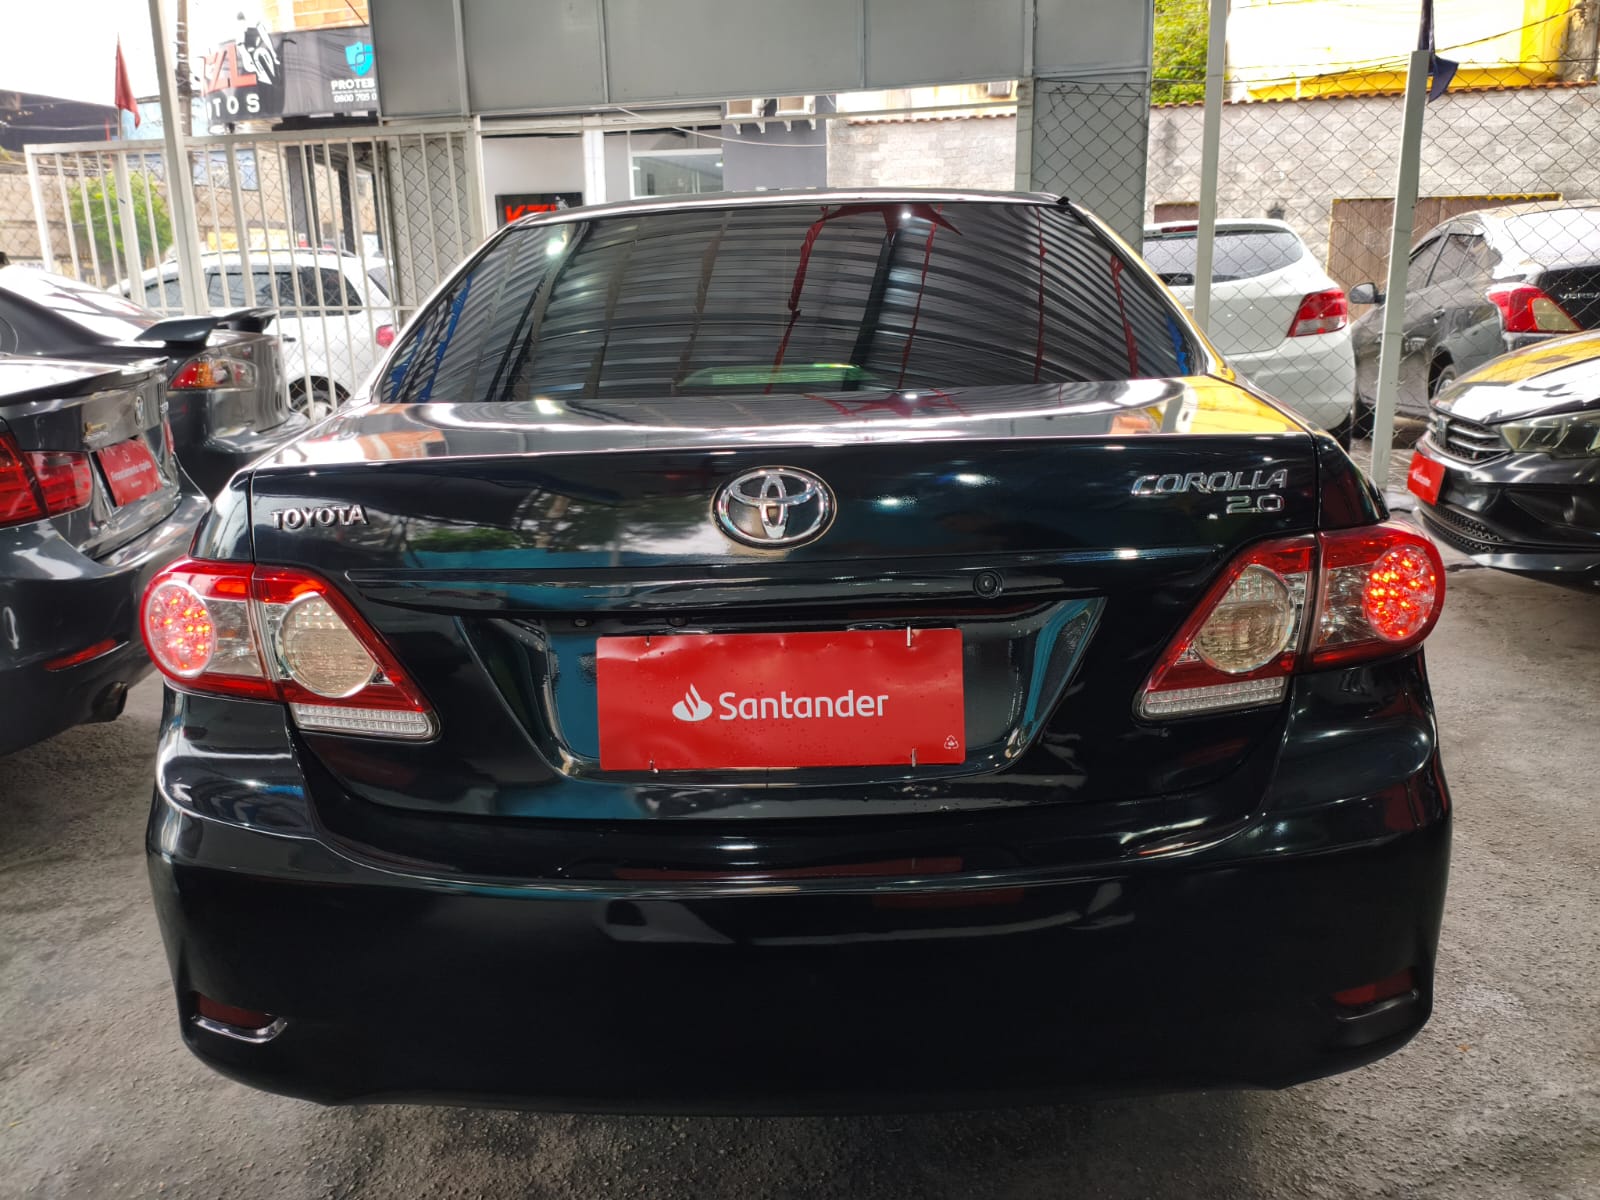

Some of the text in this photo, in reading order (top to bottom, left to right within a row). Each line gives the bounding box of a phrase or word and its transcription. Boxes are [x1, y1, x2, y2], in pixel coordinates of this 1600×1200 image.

[1131, 469, 1289, 496] COROLLA
[270, 504, 369, 529] TOYOTA
[719, 690, 888, 720] Santander
